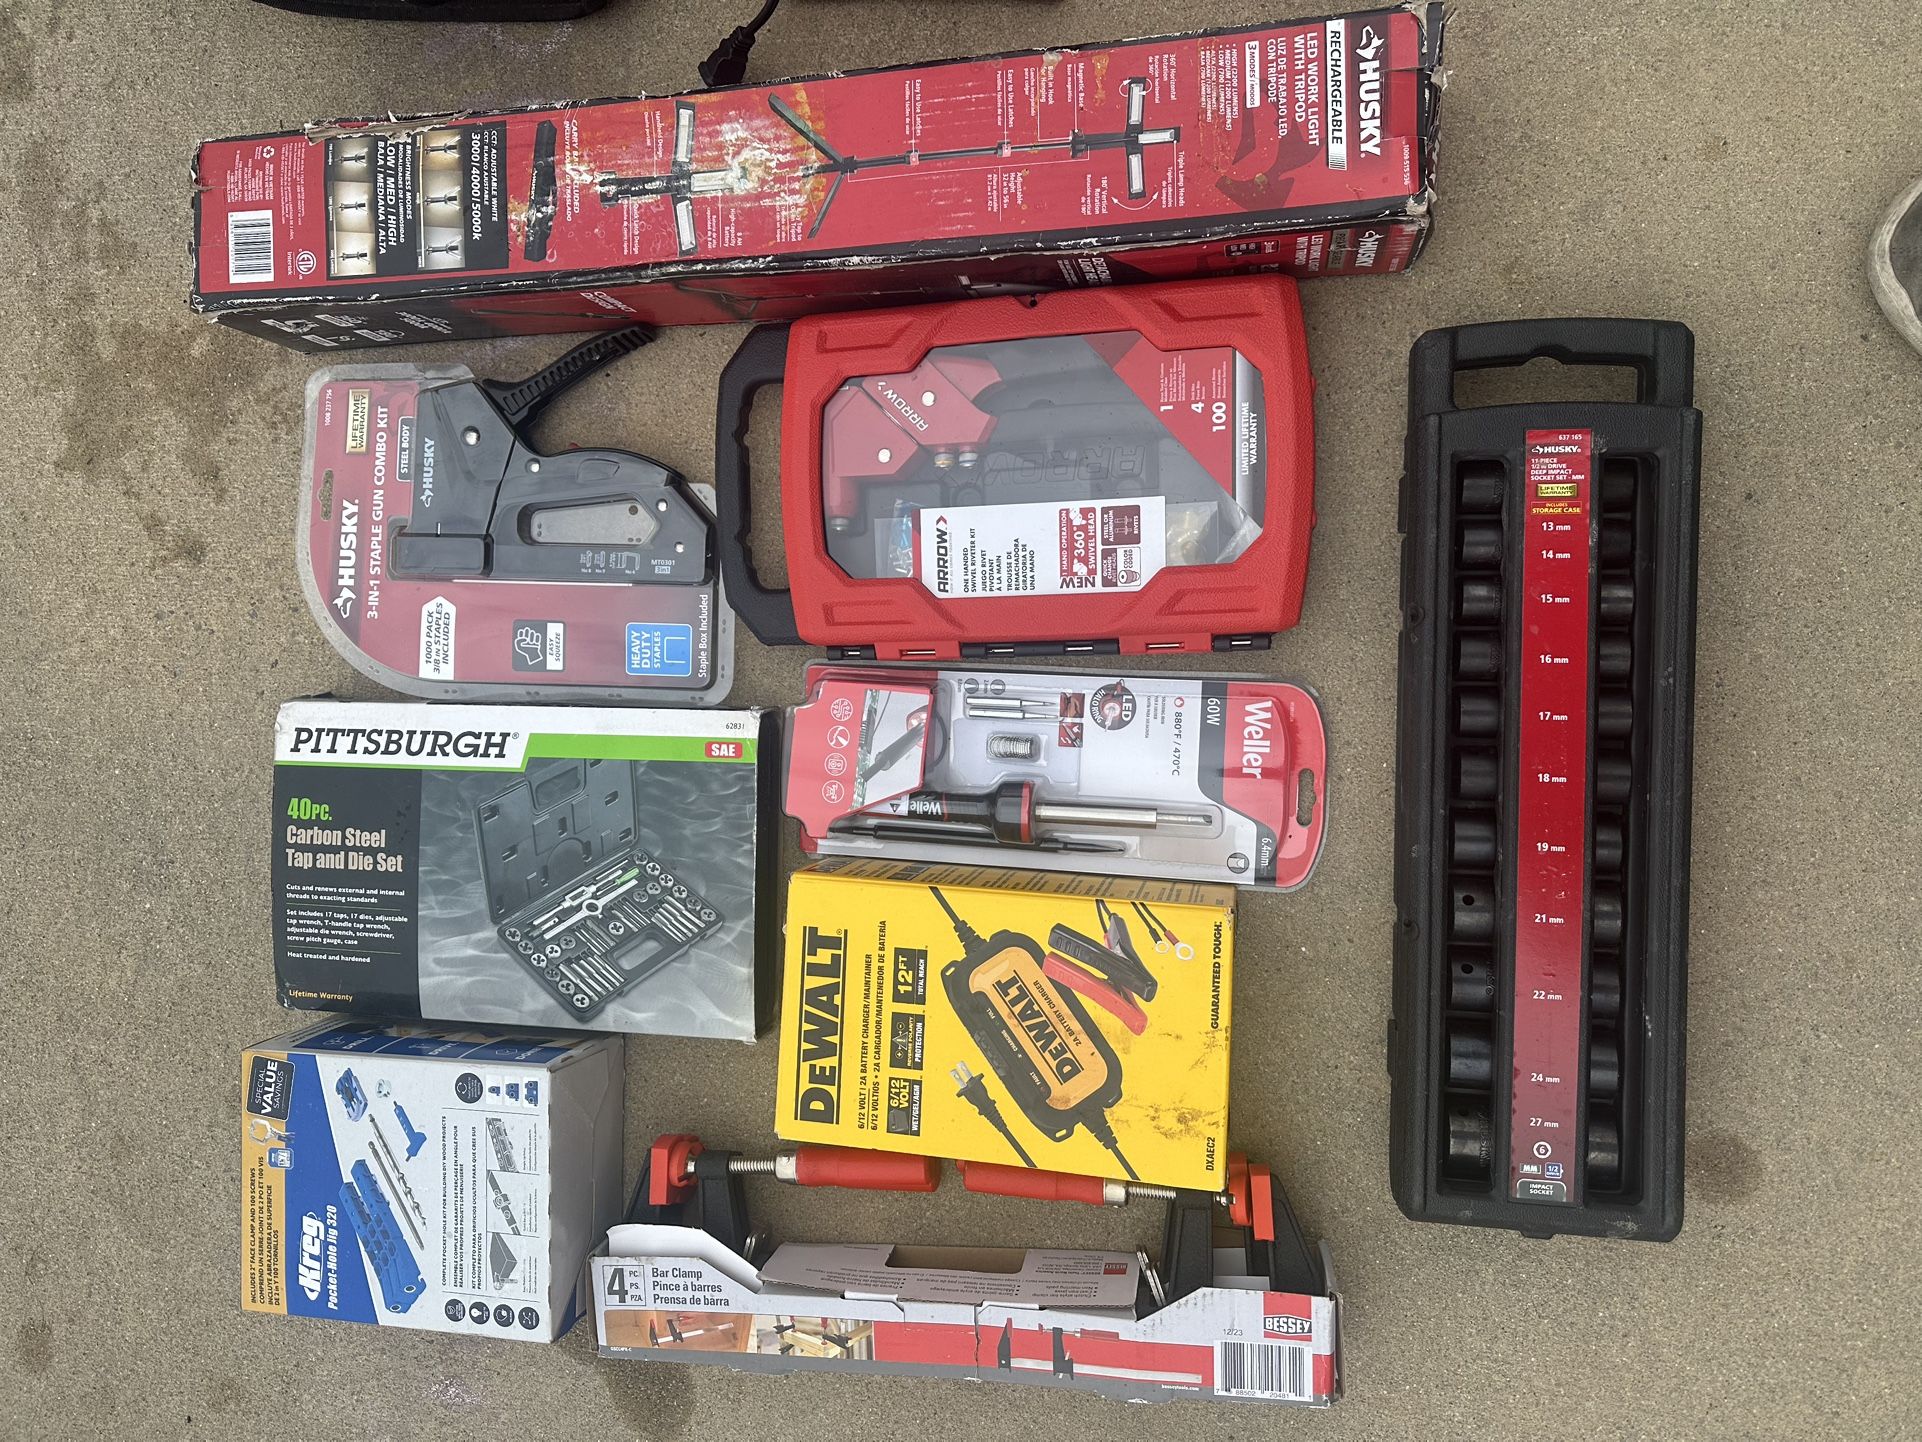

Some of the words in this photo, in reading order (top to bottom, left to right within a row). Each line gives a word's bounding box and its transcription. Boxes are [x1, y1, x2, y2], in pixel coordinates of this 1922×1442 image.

[1294, 35, 1305, 70] WITH
[1306, 32, 1319, 59] LED
[1077, 63, 1085, 92] Magnetic
[1307, 63, 1319, 105] WORK
[1330, 31, 1343, 146] RECHARGEABLE
[1294, 74, 1306, 123] TRIPOD
[1359, 61, 1380, 158] HUSKY
[1307, 109, 1319, 147] LIGHT
[377, 141, 385, 166] BAJA
[386, 140, 396, 167] LOW
[377, 174, 386, 220] MEDIANA
[387, 177, 397, 205] MED
[378, 229, 387, 256] ALTA
[387, 215, 397, 246] HIGH
[351, 394, 361, 449] LIFETIME
[359, 393, 367, 449] WARRANTY
[377, 406, 388, 428] KIT
[883, 389, 929, 431] ARROW
[1191, 401, 1204, 414] 4
[1212, 402, 1226, 432] 100
[1241, 402, 1249, 439] LIFETIME
[401, 424, 410, 448] BODY
[1249, 412, 1258, 465] WARRANTY
[1543, 445, 1578, 454] HUSKY
[374, 432, 387, 486] COMBO
[400, 449, 410, 473] STEEL
[423, 437, 435, 489] HUSKY
[1241, 442, 1249, 476] LIMITED
[372, 489, 385, 521] GUN
[1087, 512, 1095, 535] HEAD
[1541, 522, 1554, 531] 13
[337, 498, 359, 585] HUSKY
[369, 524, 382, 575] STAPLE
[1088, 537, 1096, 569] SWIVEL
[1541, 550, 1554, 559] 14
[936, 528, 949, 593] ARROW
[1059, 576, 1096, 589] NEW
[367, 579, 380, 619] 3-IN-1
[699, 594, 709, 630] Included
[1540, 594, 1553, 603] 15
[425, 610, 434, 638] PACK
[442, 611, 451, 665] INCLUDED
[425, 639, 433, 665] 1000
[631, 630, 641, 668] HEAVY
[641, 630, 651, 668] DUTY
[653, 631, 661, 668] STAPLES
[698, 632, 708, 649] Box
[698, 651, 709, 678] Staple
[1539, 654, 1552, 664] 16
[1091, 688, 1106, 707] HALO
[1121, 695, 1133, 722] LED
[1091, 706, 1104, 724] RING
[1206, 698, 1220, 726] 60W
[1538, 711, 1551, 721] 17
[291, 727, 512, 759] PITTSBURGH
[711, 744, 736, 758] SAE
[1242, 700, 1273, 779] Weller
[1537, 773, 1550, 783] 18
[286, 825, 342, 847] Carbon
[345, 828, 386, 849] Steel
[1536, 842, 1549, 852] 19
[286, 849, 313, 870] Tap
[316, 851, 345, 870] and
[347, 851, 374, 871] Die
[376, 852, 403, 873] Set
[1260, 837, 1272, 867] 6.4mm
[319, 895, 346, 903] exacting
[338, 887, 365, 895] external
[1534, 913, 1546, 923] 21
[876, 920, 887, 952] BATERÍA
[877, 953, 885, 964] DE
[289, 989, 319, 999] Lifetime
[319, 991, 353, 1002] Warranty
[861, 954, 872, 1039] CHARGER/MAINTAINER
[1532, 990, 1545, 1000] 22
[1547, 993, 1563, 1001] mm
[800, 926, 842, 1124] DEWALT
[873, 965, 885, 1060] CARGADOR/MANTENEDOR
[914, 1022, 923, 1062] PROTECTION
[994, 975, 1083, 1084] DEWALT
[860, 1040, 869, 1074] BATTERY
[873, 1062, 881, 1073] 2A
[254, 1068, 266, 1104] SPECIAL
[260, 1060, 278, 1115] VALUE
[273, 1070, 284, 1109] SAVINGS
[859, 1075, 868, 1086] 2A
[1530, 1072, 1543, 1082] 24
[858, 1092, 867, 1111] VOLT
[871, 1081, 880, 1111] VOLTIOS
[889, 1079, 900, 1107] 6/12
[899, 1079, 910, 1108] VOLT
[857, 1113, 866, 1130] 6/12
[911, 1084, 921, 1131] WET/GEL/AGM
[871, 1113, 879, 1131] 6/12
[1529, 1117, 1542, 1127] 27
[1205, 1136, 1215, 1172] DXAEC2
[326, 1205, 337, 1227] 320
[326, 1227, 339, 1244] Jig
[298, 1215, 325, 1293] Kreg
[249, 1271, 257, 1304] INCLUDES
[326, 1244, 338, 1310] Pocket-Hole
[652, 1267, 670, 1278] Bar
[671, 1267, 703, 1281] Clamp
[652, 1281, 681, 1292] Pince
[682, 1281, 689, 1292] à
[690, 1281, 723, 1293] barres
[653, 1293, 688, 1305] Prensa
[690, 1295, 702, 1305] de
[703, 1295, 730, 1307] barra
[1223, 1328, 1244, 1336] 12/23
[1265, 1317, 1311, 1333] BESSEY
